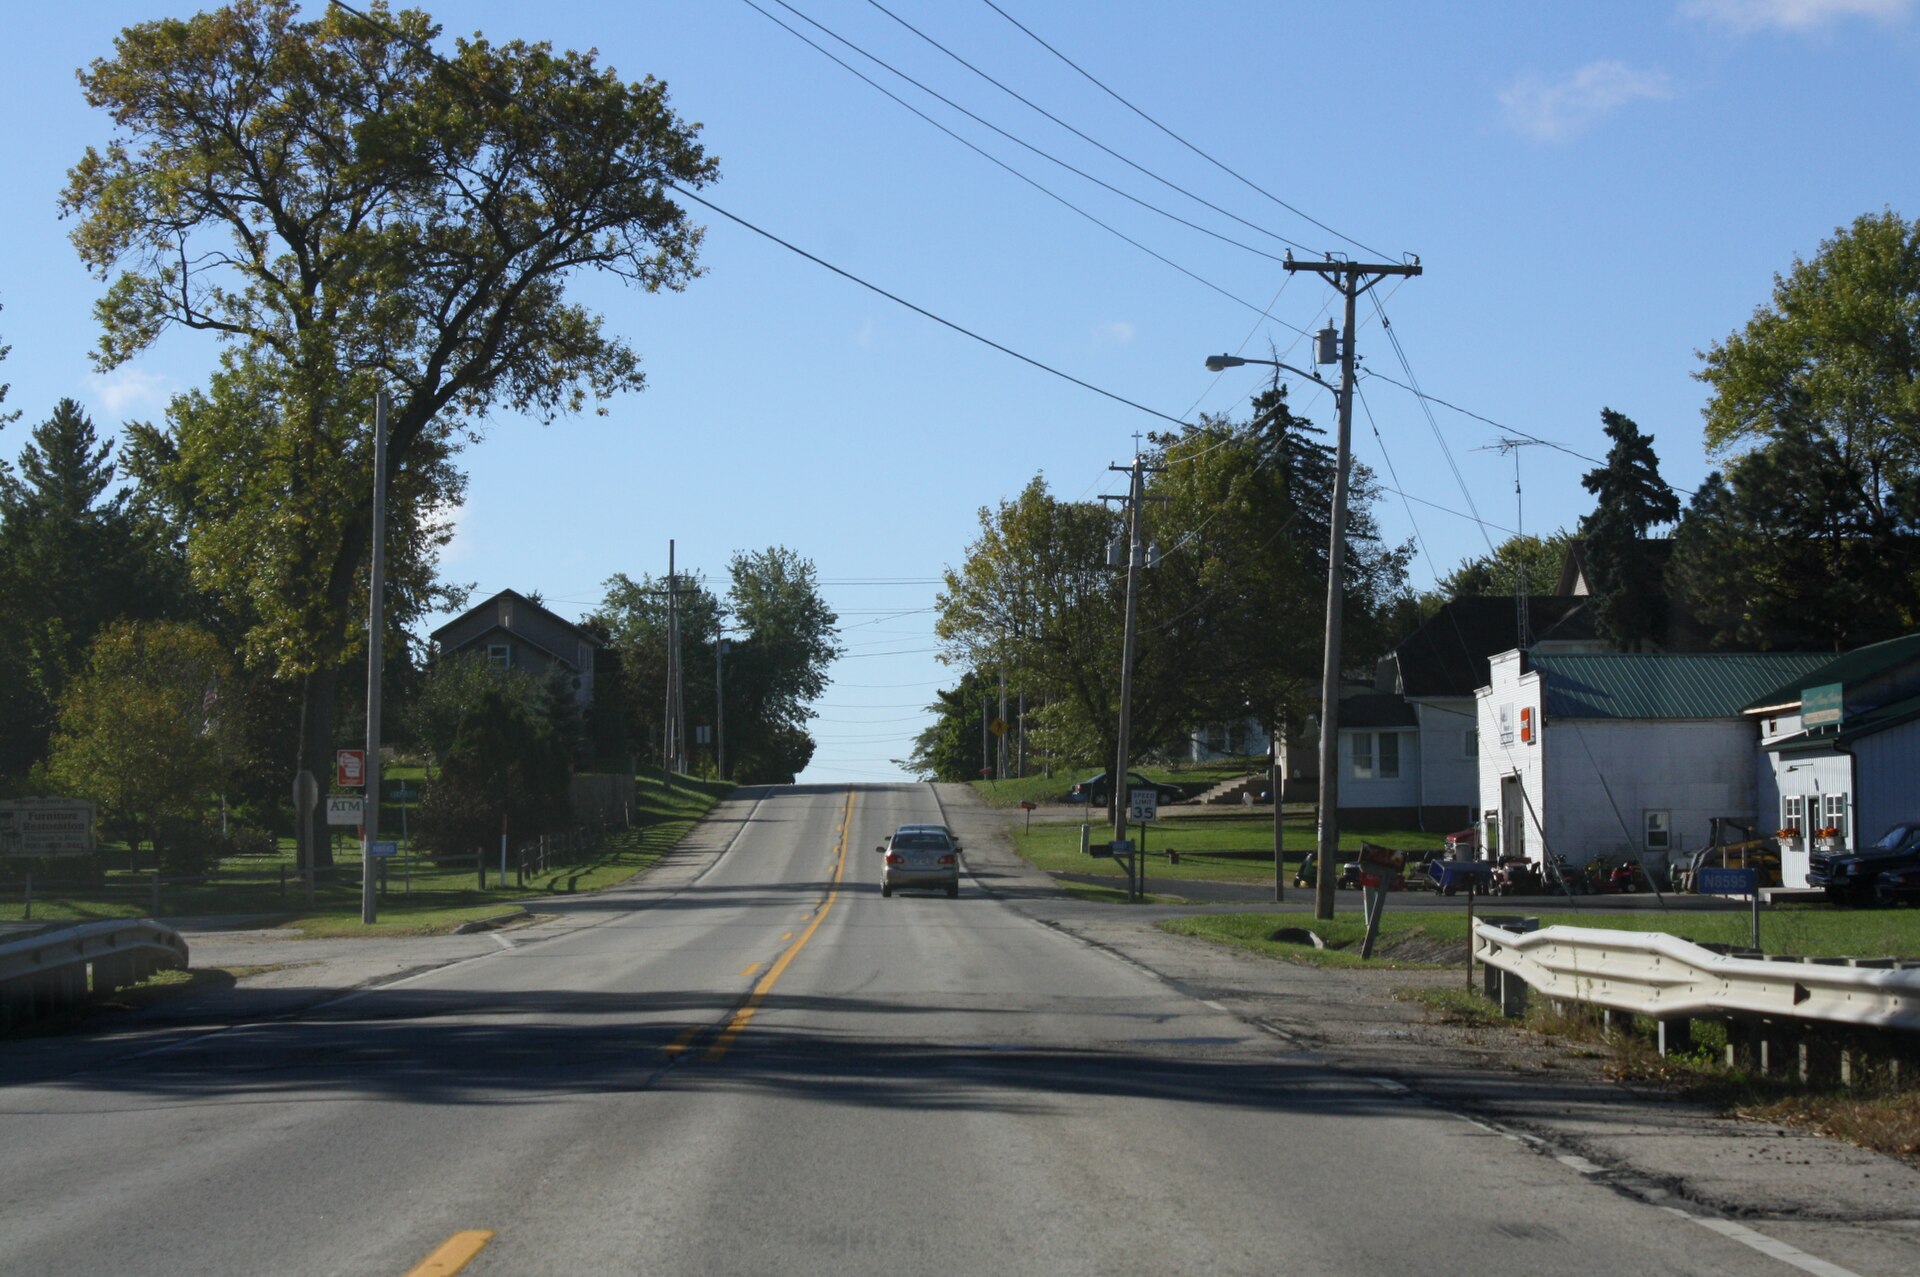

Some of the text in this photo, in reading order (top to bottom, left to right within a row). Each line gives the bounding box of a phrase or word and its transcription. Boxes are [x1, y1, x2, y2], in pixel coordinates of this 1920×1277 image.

[330, 800, 360, 811] ATM
[28, 811, 78, 821] Furniture
[1133, 806, 1154, 819] 35
[23, 822, 85, 831] Restoration
